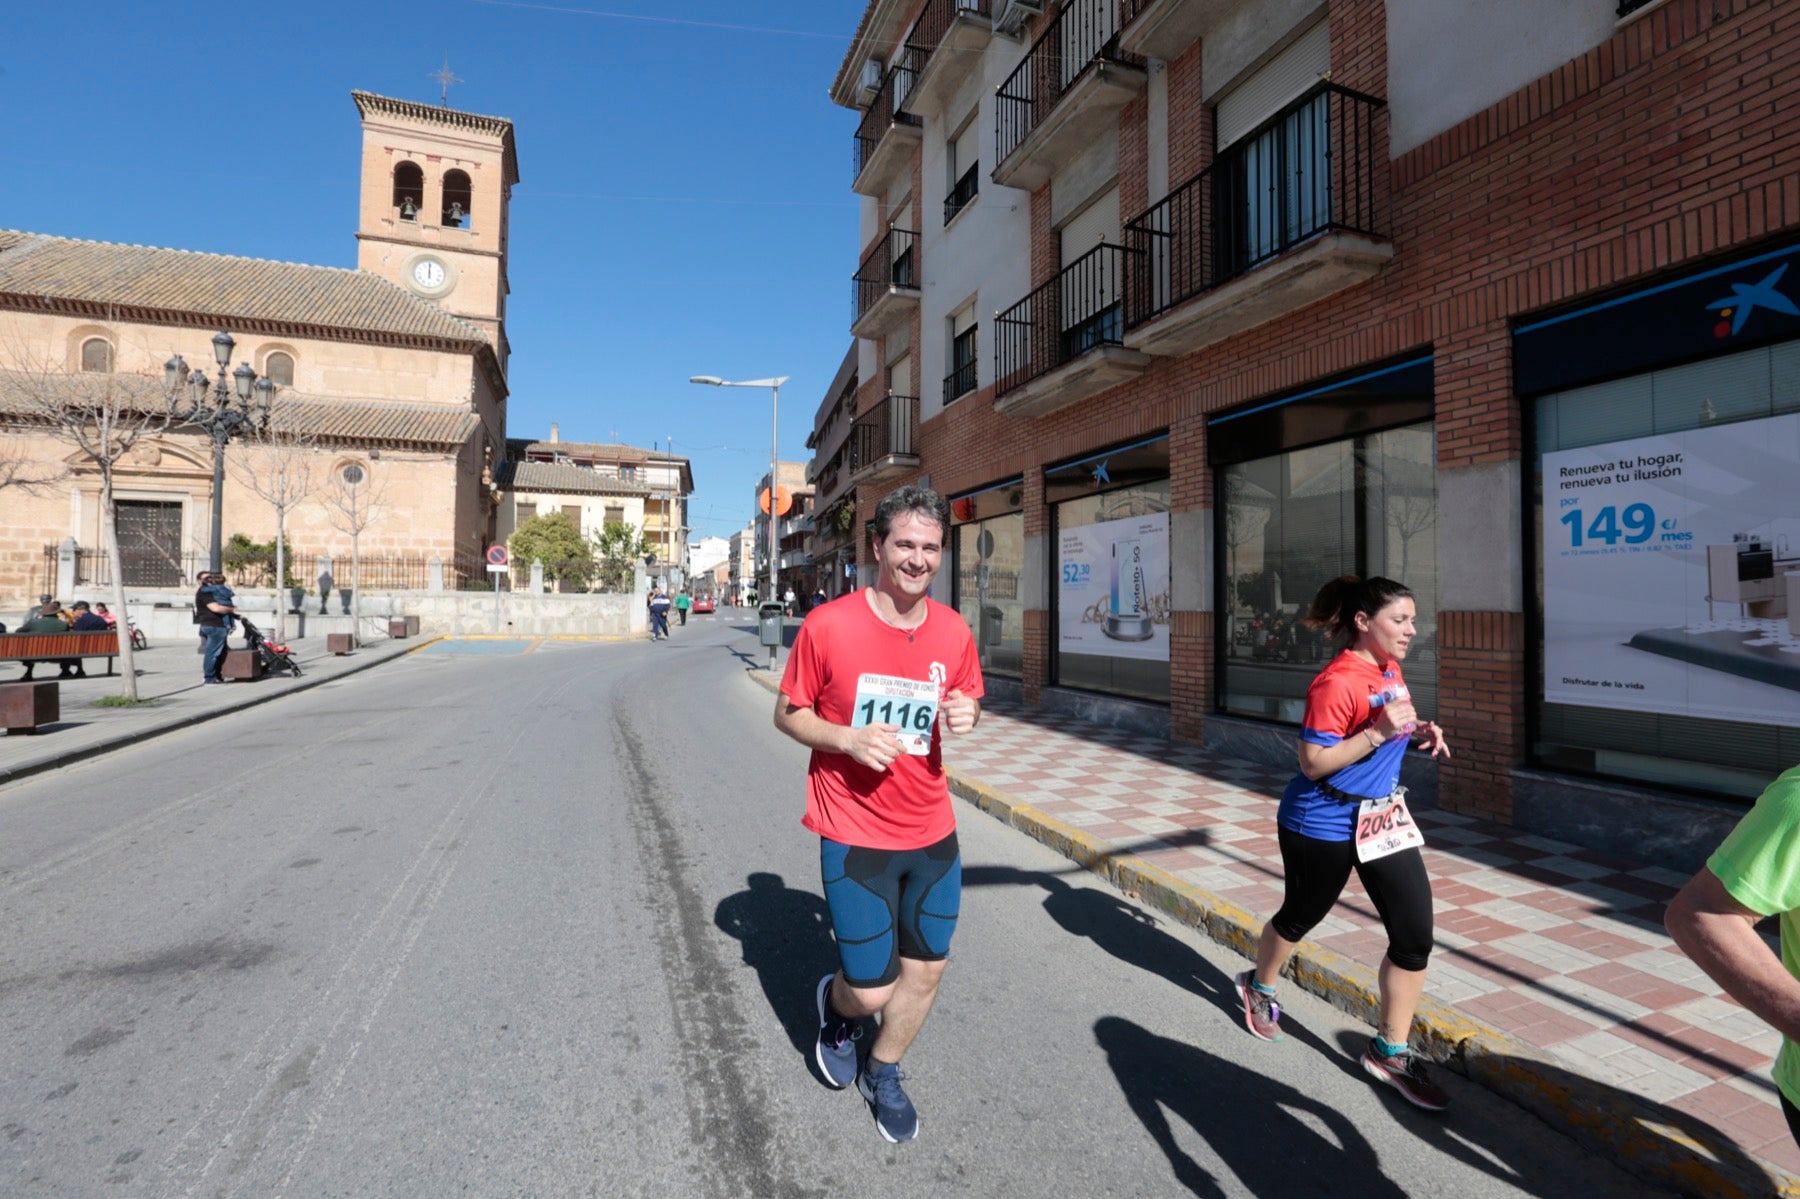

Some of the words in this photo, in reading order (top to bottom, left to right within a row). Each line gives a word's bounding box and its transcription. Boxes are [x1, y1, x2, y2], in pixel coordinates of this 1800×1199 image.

[1560, 462, 1615, 477] Renueva
[1619, 460, 1633, 470] tu
[1637, 453, 1683, 469] hogar,
[1560, 475, 1612, 490] renueva
[1615, 473, 1629, 483] tu
[1634, 465, 1681, 481] ilusión
[1560, 497, 1579, 508] por
[1561, 503, 1655, 547] 149
[1661, 531, 1693, 542] mes
[1133, 546, 1140, 563] 5G
[893, 679, 912, 690] PREMIO
[1562, 677, 1599, 686] Disfrutar
[1625, 682, 1645, 690] vida
[861, 699, 932, 730] 1116
